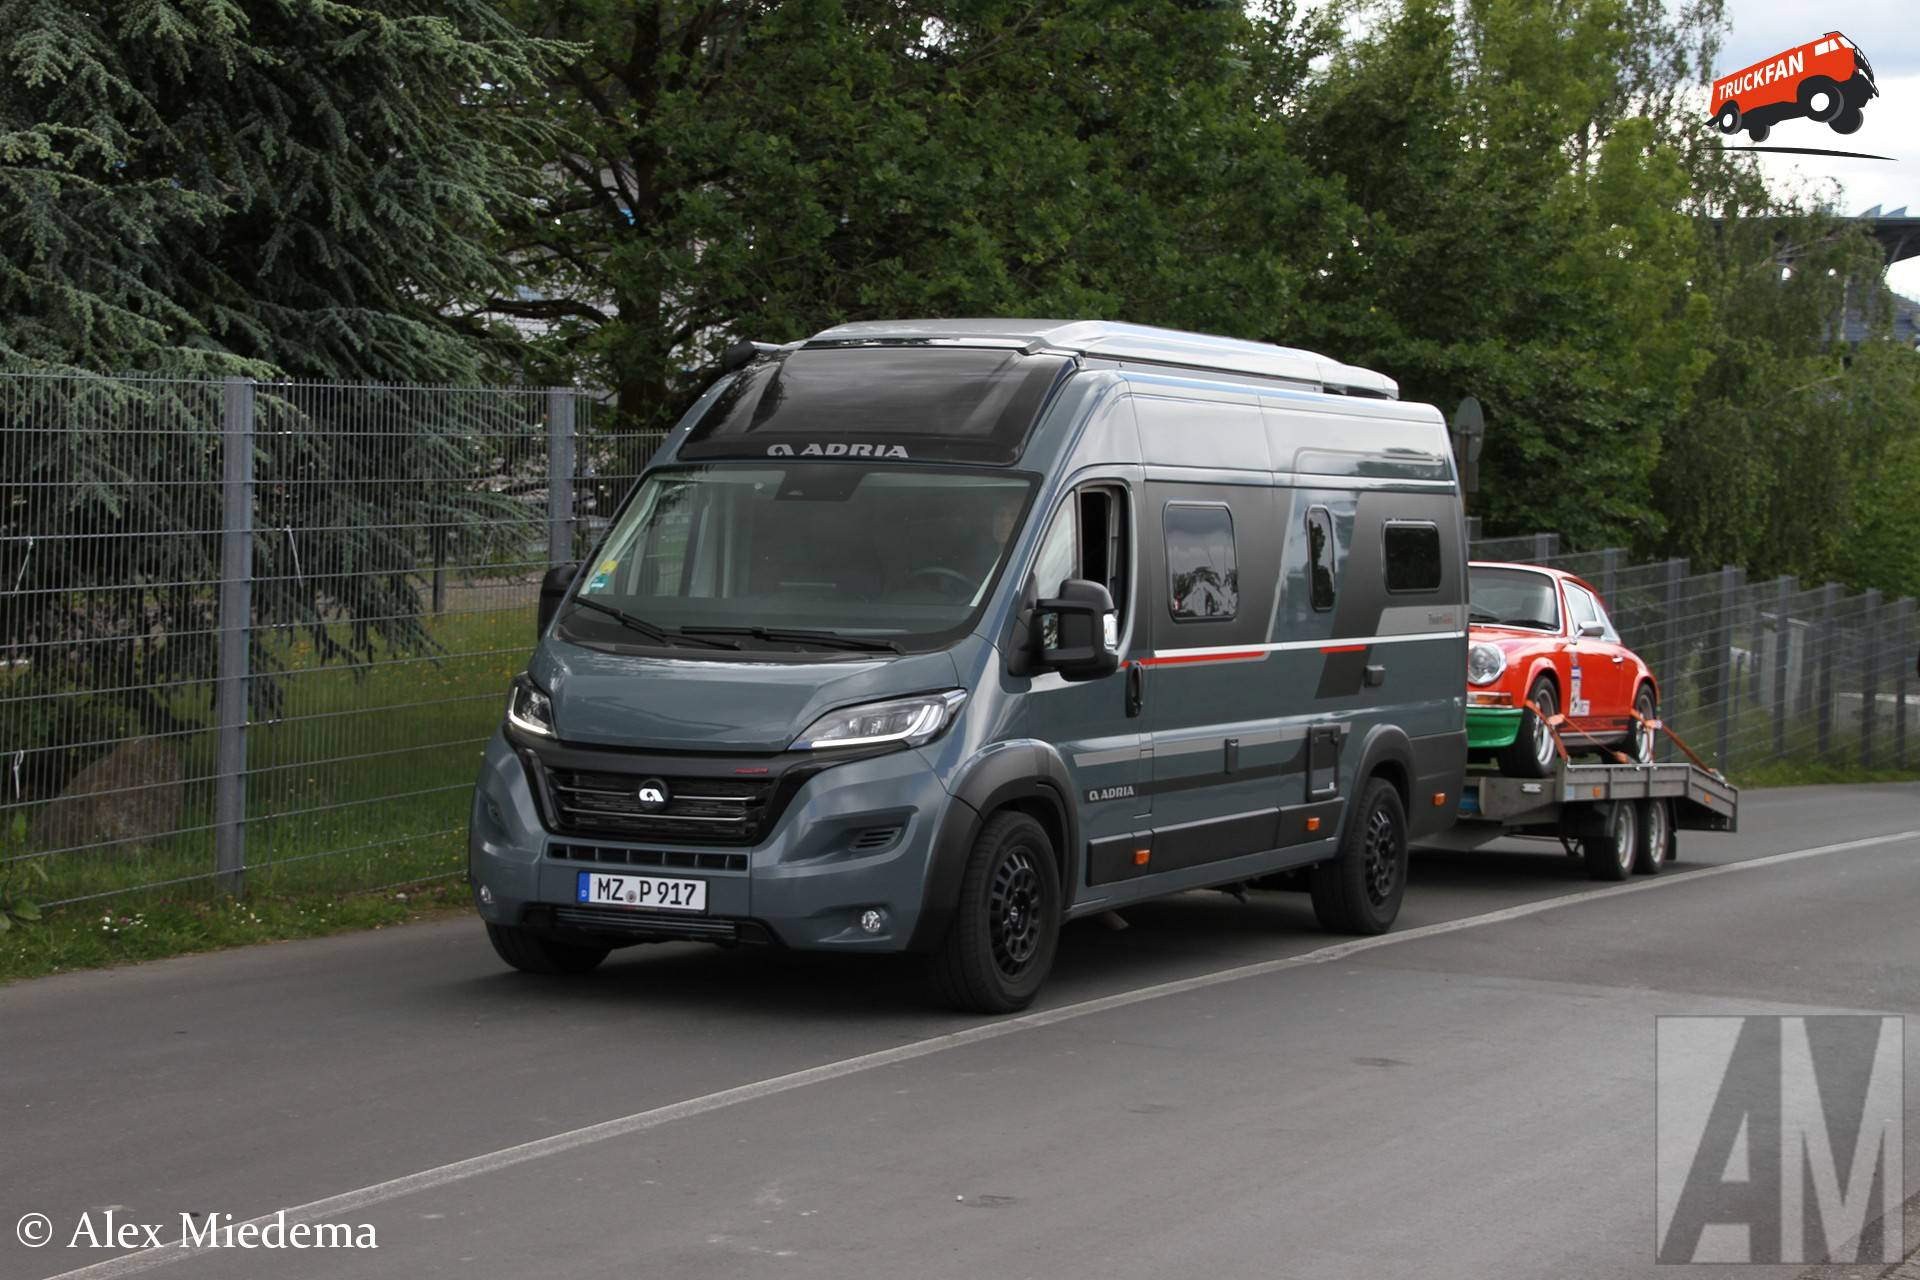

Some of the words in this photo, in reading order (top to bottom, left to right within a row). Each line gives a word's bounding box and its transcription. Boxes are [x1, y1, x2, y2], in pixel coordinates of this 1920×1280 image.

[800, 443, 909, 458] ADRIA
[1101, 785, 1135, 800] ADRIA
[597, 877, 624, 901] MZ
[639, 880, 652, 902] P
[657, 881, 697, 906] 917
